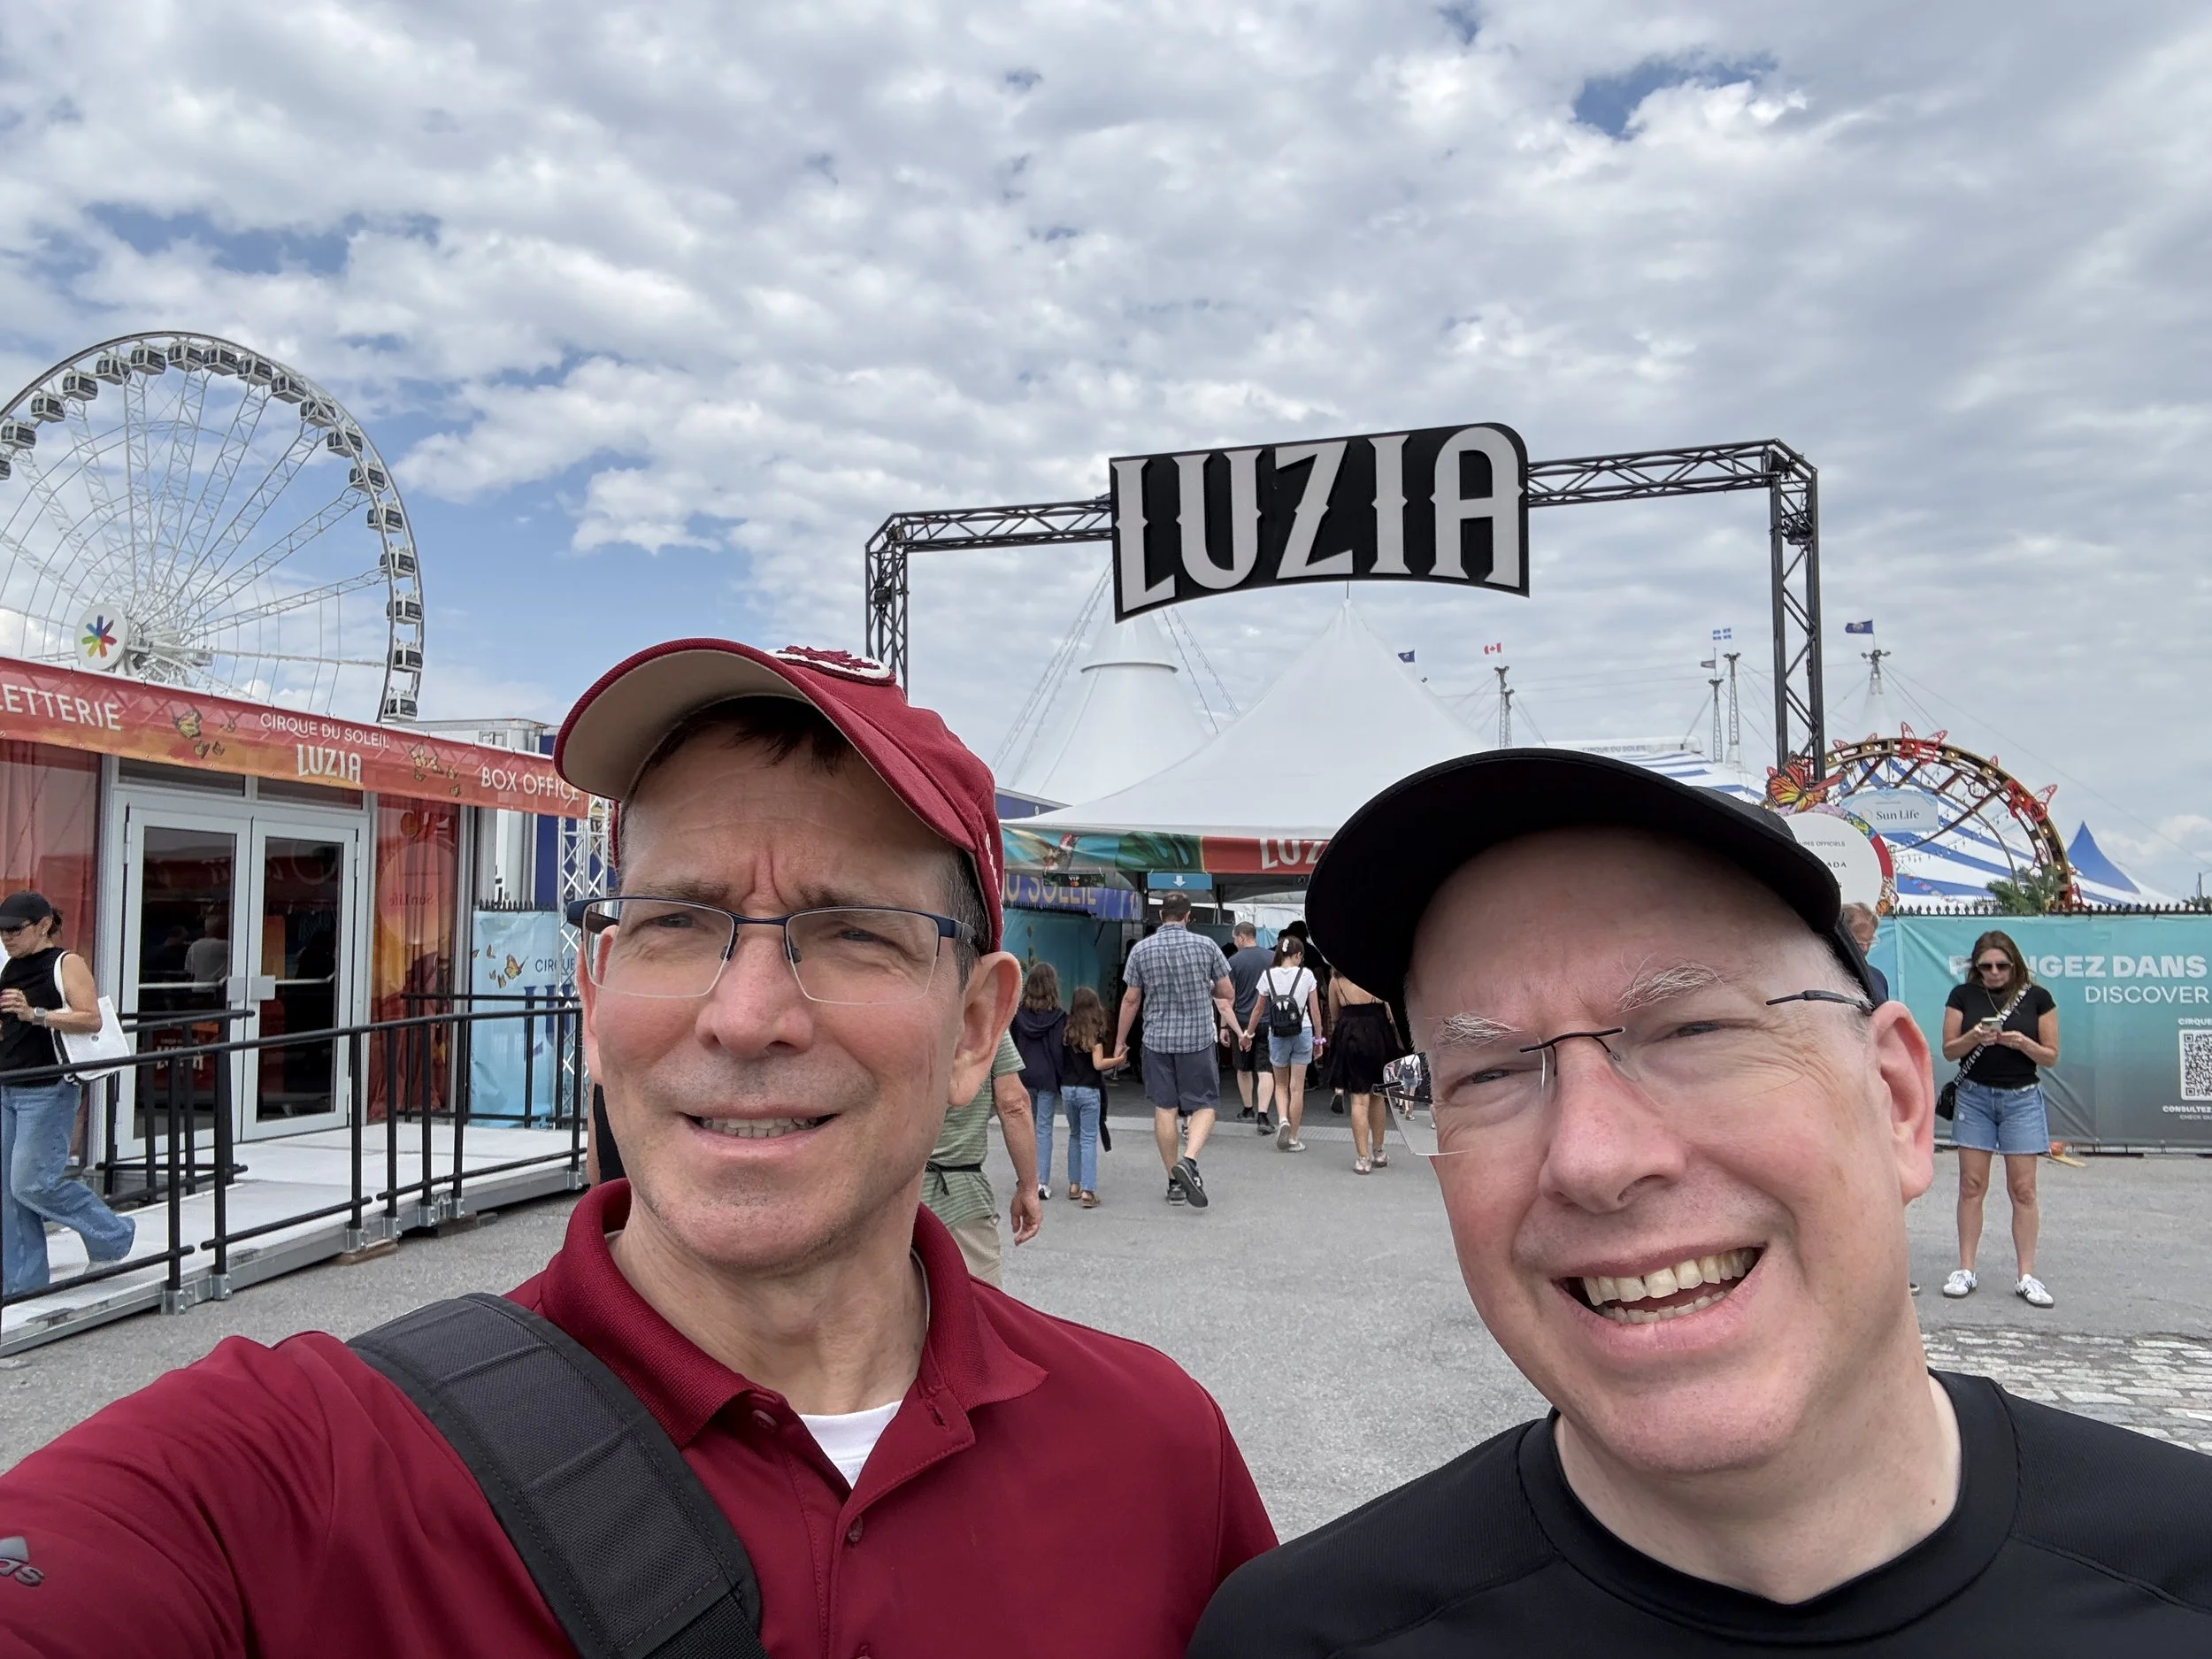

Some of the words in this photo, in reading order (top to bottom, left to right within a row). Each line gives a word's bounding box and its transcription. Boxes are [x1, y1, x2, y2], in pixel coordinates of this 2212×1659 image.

[1110, 426, 1524, 613] LUZIA
[0, 683, 121, 732] ETTERIE
[260, 712, 318, 739] CIRQUE
[321, 722, 342, 741] DU
[344, 728, 390, 749] SOLEIL
[296, 743, 363, 786] LUZIA
[480, 765, 518, 793] BOX
[523, 773, 580, 801] OFFICE
[1876, 810, 1897, 821] Sun
[1899, 808, 1920, 820] Life
[1259, 839, 1325, 871] LUZ
[2112, 955, 2208, 979] DANS
[2085, 985, 2210, 1004] DISCOVER
